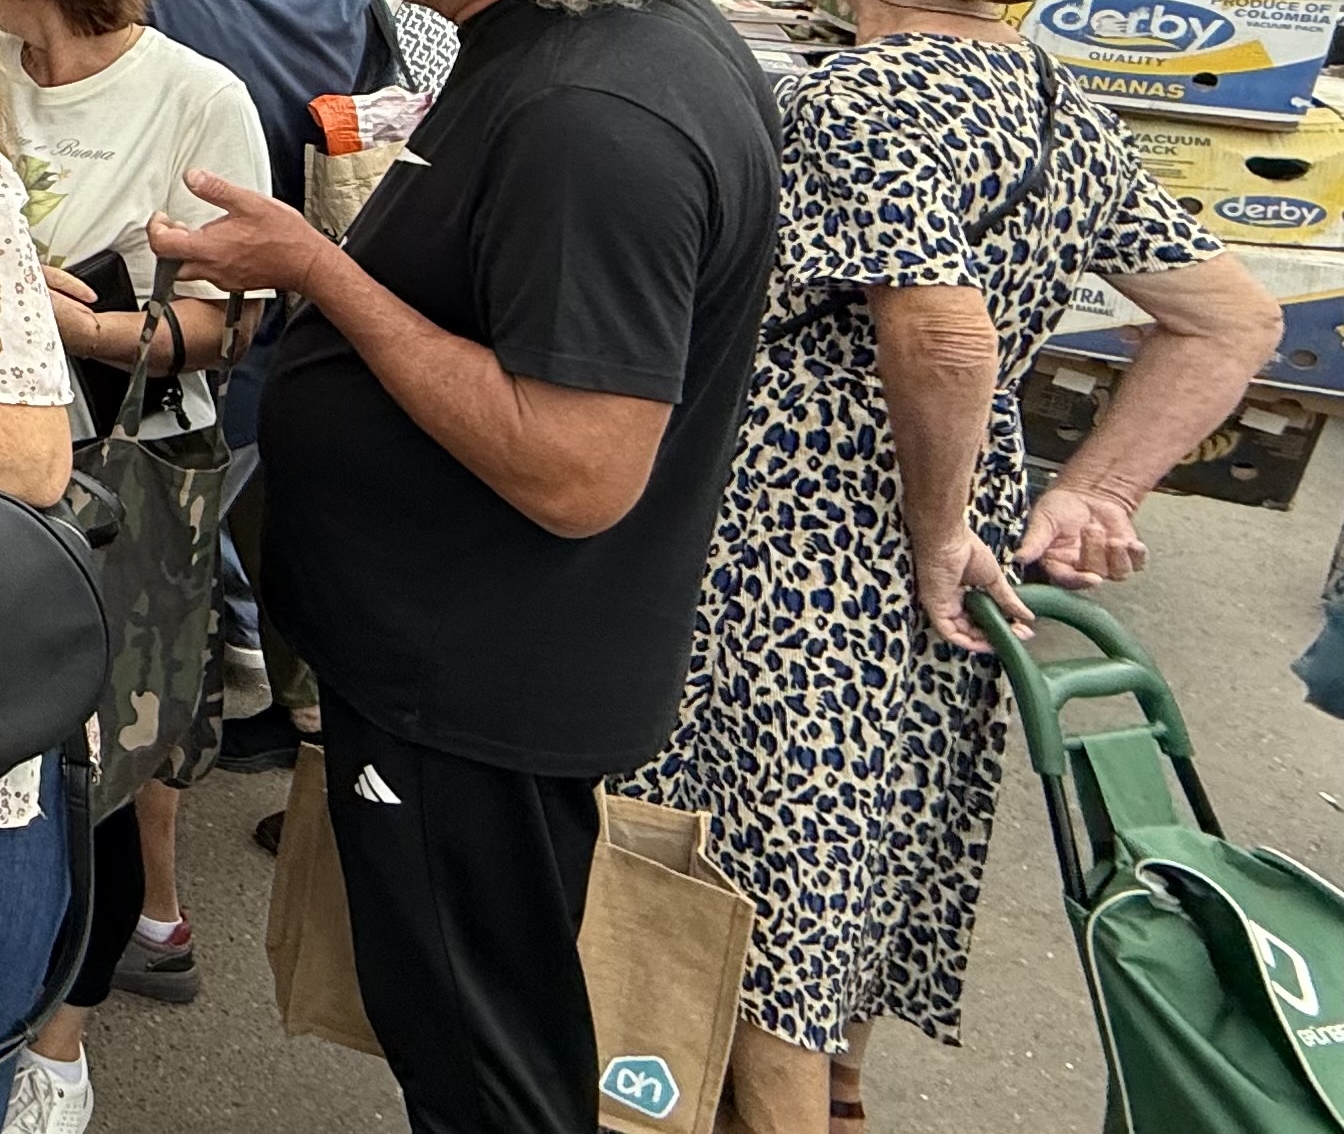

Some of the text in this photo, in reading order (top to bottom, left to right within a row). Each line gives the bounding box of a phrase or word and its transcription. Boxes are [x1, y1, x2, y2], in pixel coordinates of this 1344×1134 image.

[1305, 2, 1332, 13] OF
[1234, 8, 1332, 24] COLOMBIA
[1246, 20, 1325, 33] VACUUM PACK
[1088, 51, 1166, 67] QUALITY
[1077, 74, 1186, 99] ANANAS
[1133, 132, 1212, 147] VACUUM
[49, 138, 116, 161] Buona
[1135, 144, 1178, 156] ACK
[1222, 196, 1322, 227] derby
[1071, 287, 1106, 306] TRA
